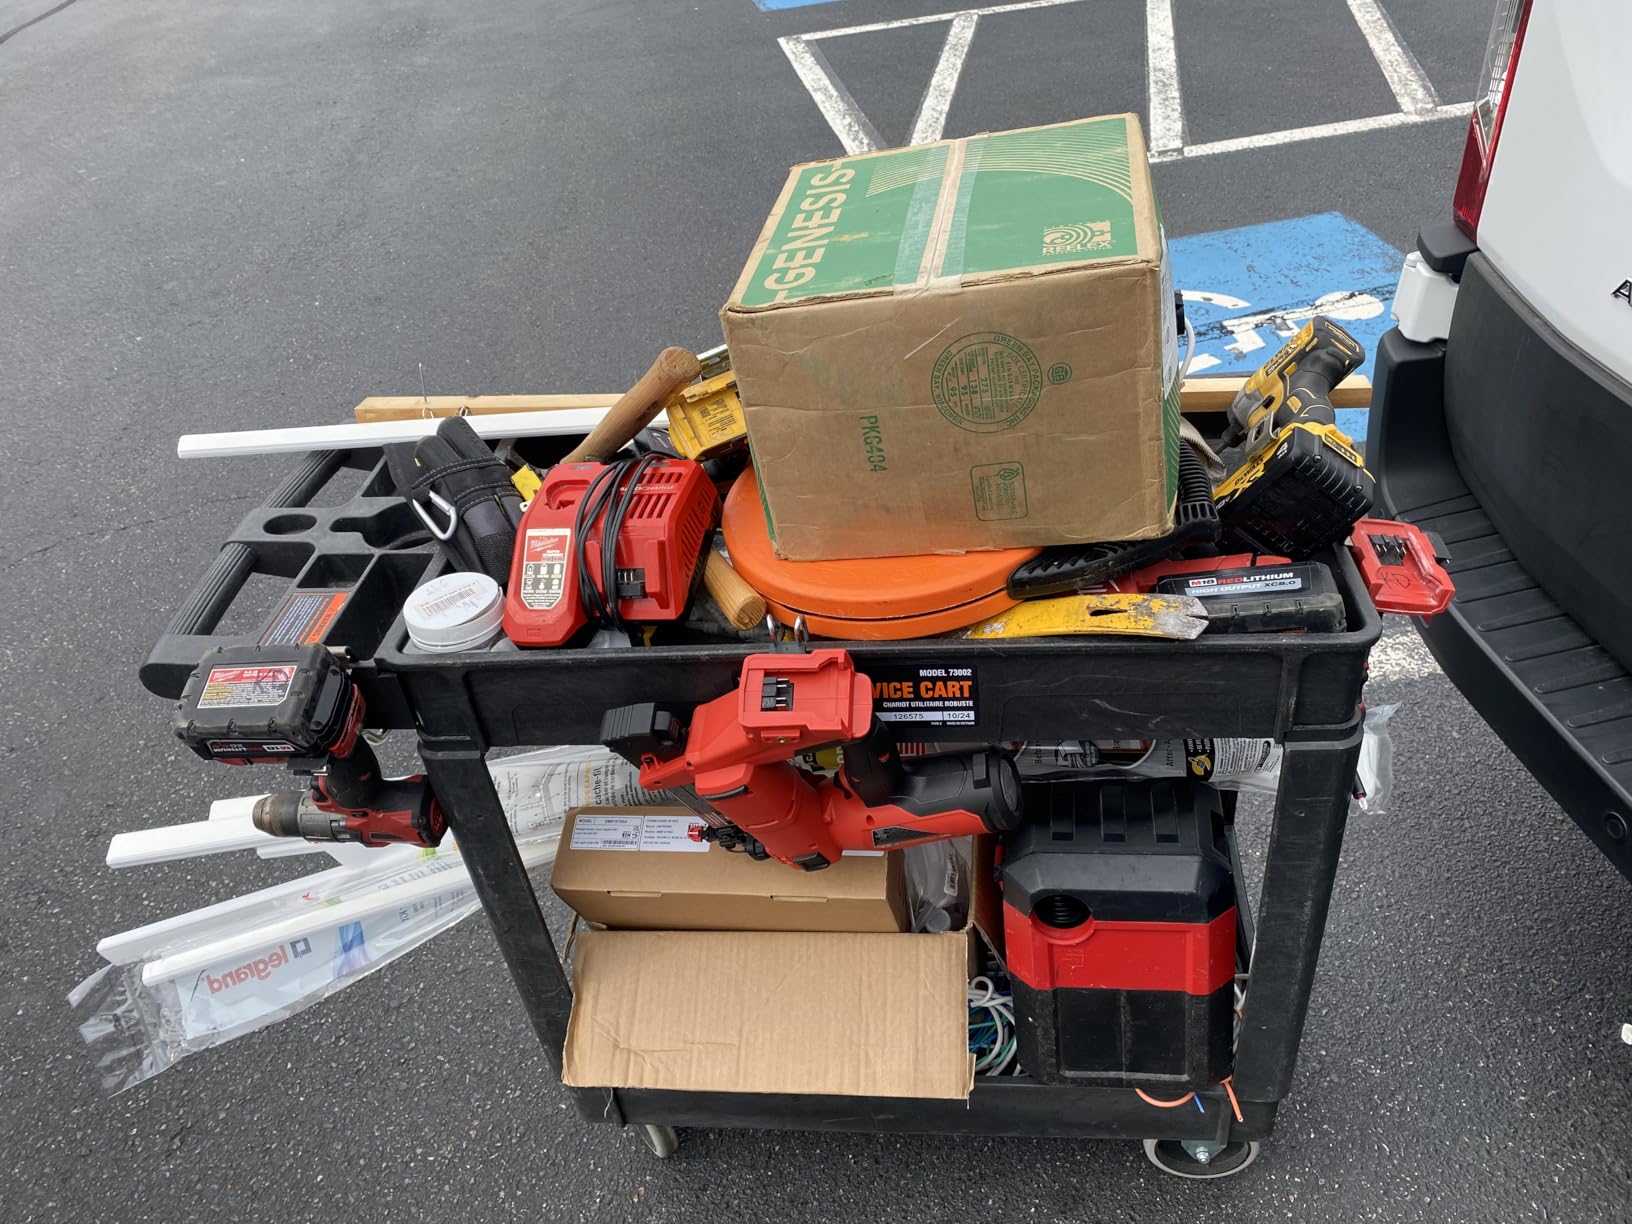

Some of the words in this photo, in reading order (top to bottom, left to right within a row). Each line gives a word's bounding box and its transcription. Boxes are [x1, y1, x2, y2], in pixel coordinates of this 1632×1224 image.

[764, 168, 856, 290] GENESIS
[1042, 240, 1112, 254] REELEX
[993, 335, 1023, 352] GREEN
[1022, 350, 1036, 366] BAY
[949, 386, 958, 398] 95
[960, 385, 968, 396] 95
[970, 379, 979, 395] 138
[859, 415, 888, 472] PKG404
[1190, 578, 1216, 586] M18
[1217, 571, 1294, 585] REDLITHIUM
[1219, 583, 1261, 592] OUTPUT
[920, 669, 947, 677] MODEL
[948, 668, 972, 676] 73002
[920, 680, 973, 699] CART
[894, 712, 924, 720] 126575
[947, 712, 971, 720] 10/24
